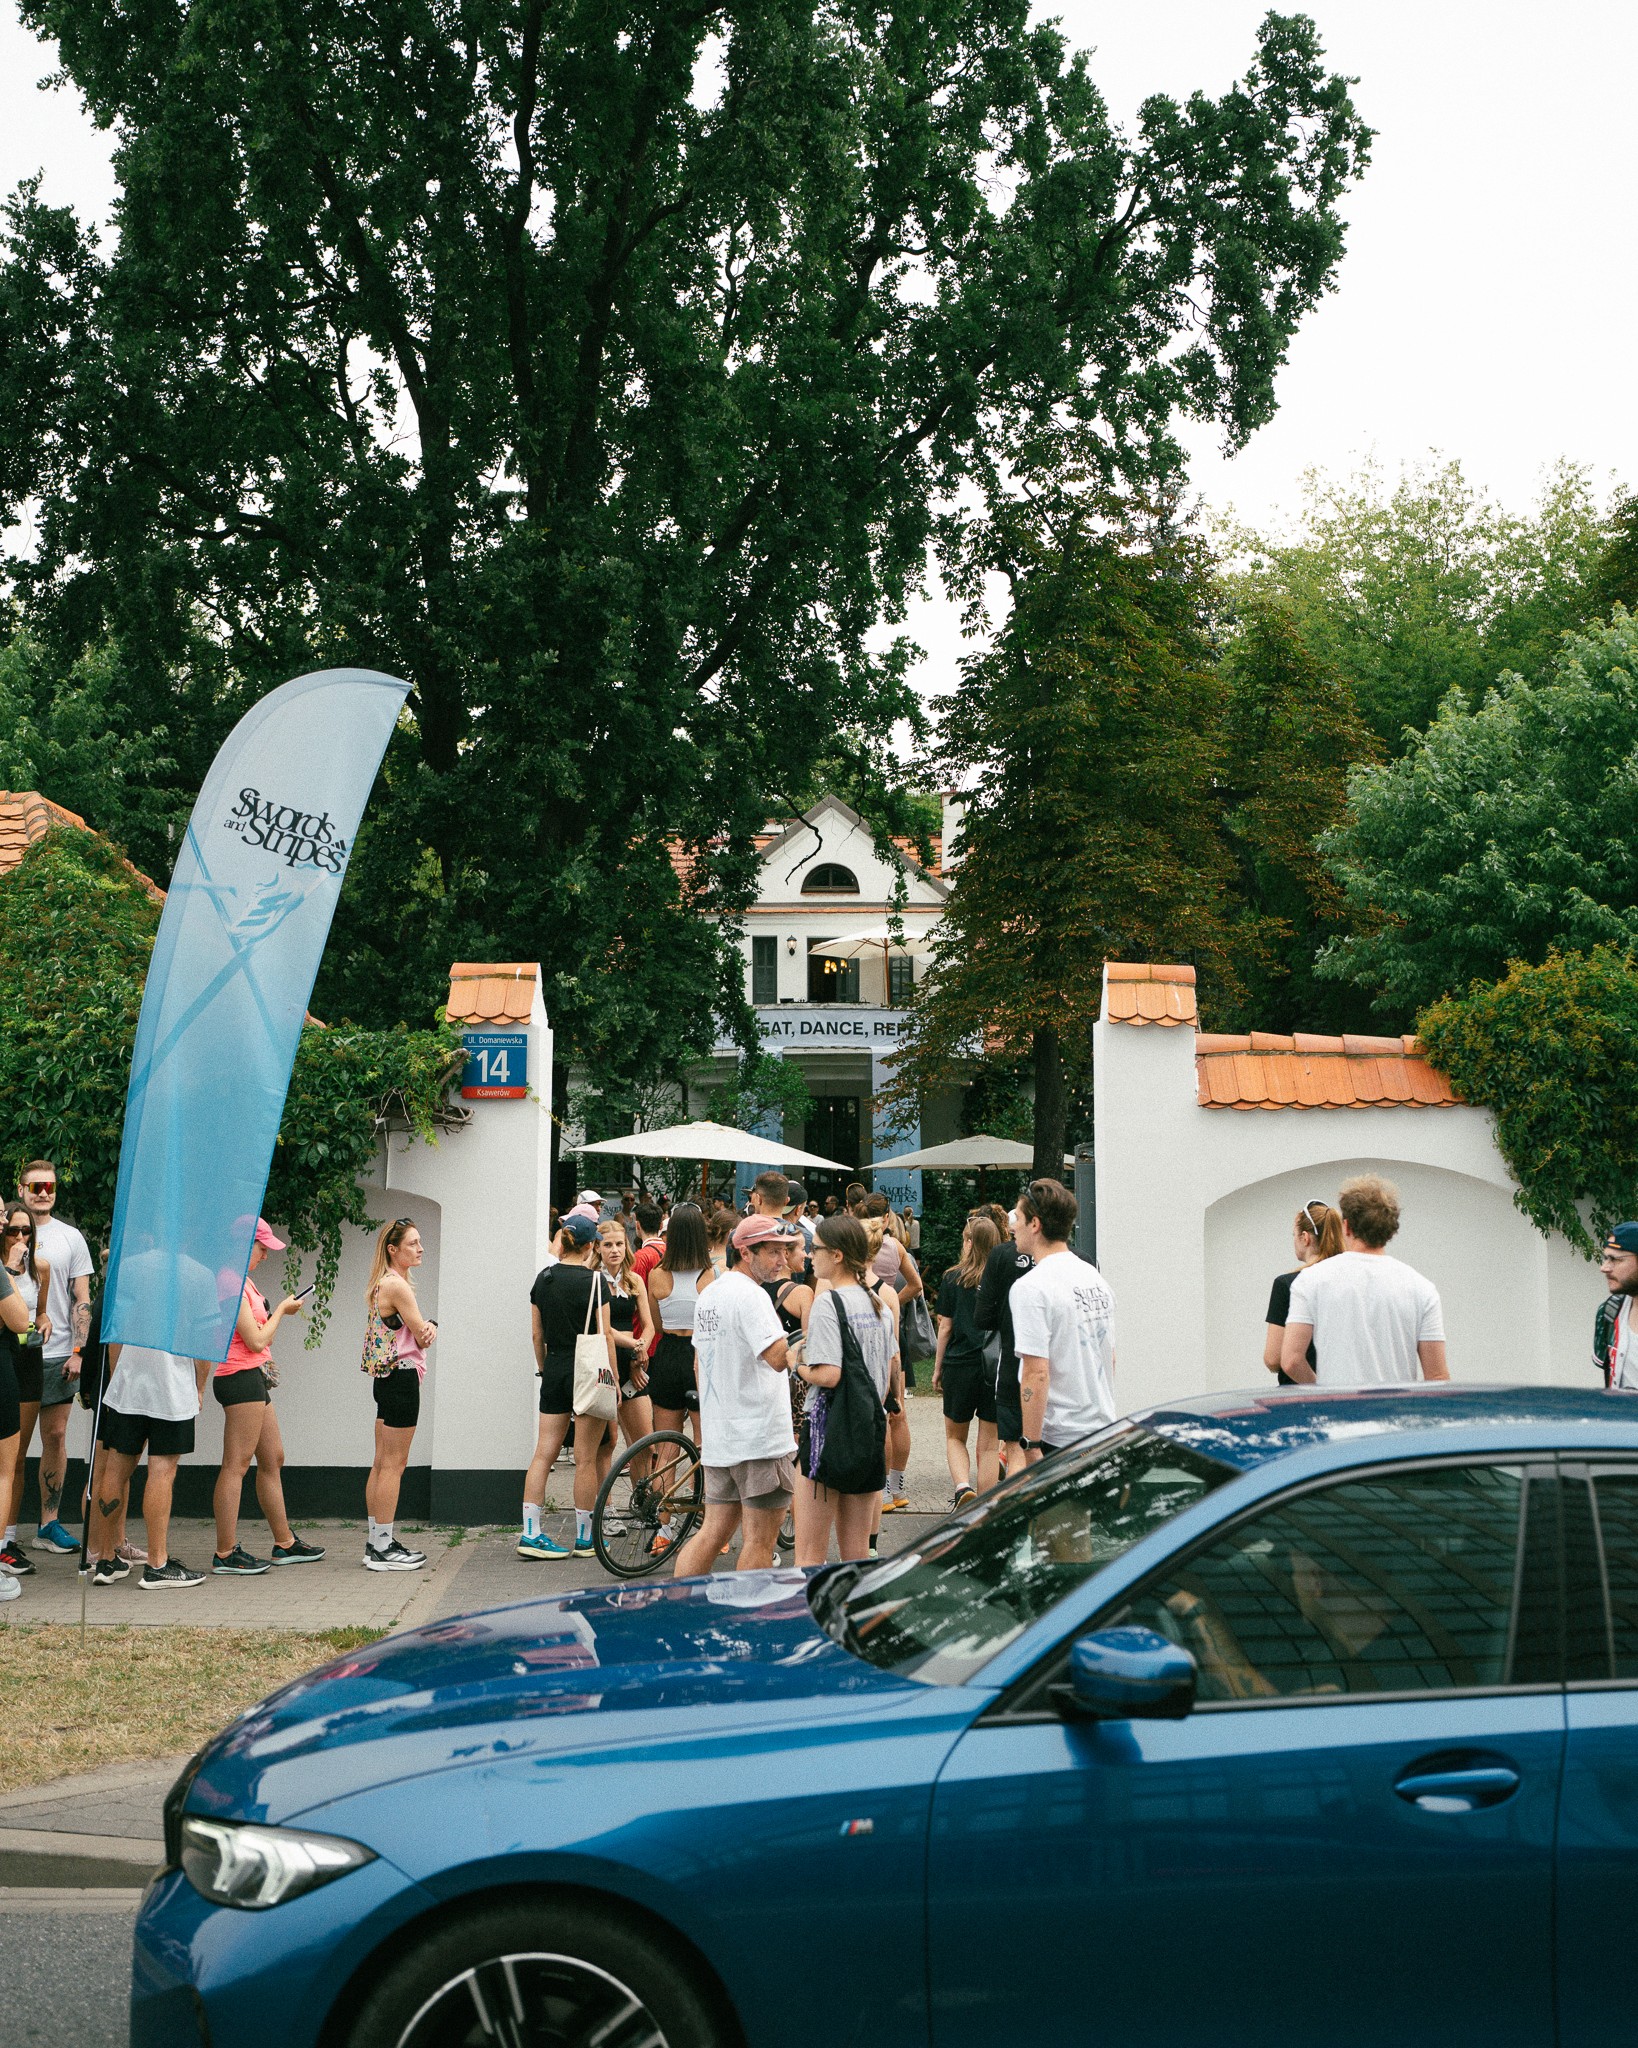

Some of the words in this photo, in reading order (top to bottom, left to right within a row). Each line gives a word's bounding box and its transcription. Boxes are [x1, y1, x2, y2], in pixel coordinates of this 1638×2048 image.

[223, 818, 247, 832] and
[231, 788, 336, 844] Swords
[241, 816, 345, 873] Stripes
[800, 1021, 869, 1039] DANCE,
[873, 1022, 926, 1037] REPE
[478, 1036, 523, 1044] Domaniewska
[476, 1050, 510, 1083] 14
[476, 1088, 510, 1097] Ksawerów
